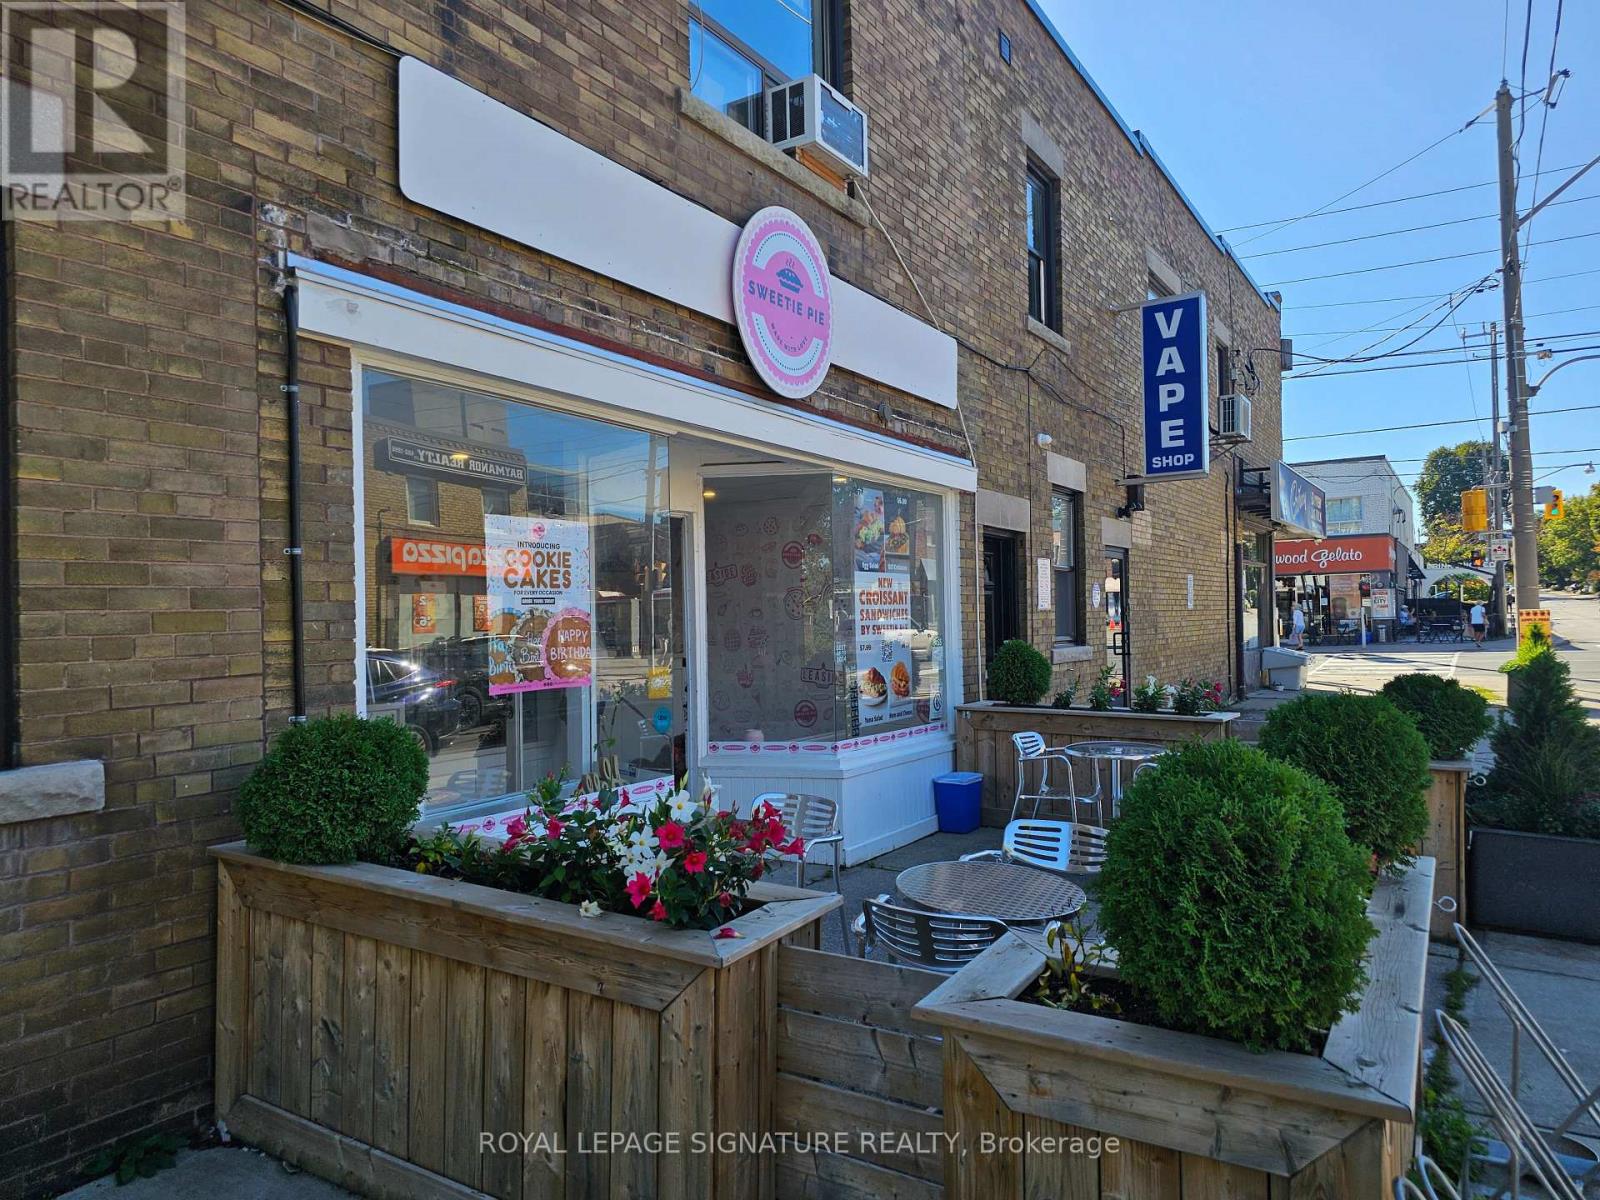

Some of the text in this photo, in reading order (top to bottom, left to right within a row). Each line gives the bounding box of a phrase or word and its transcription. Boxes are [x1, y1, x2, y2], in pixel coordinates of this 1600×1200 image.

[748, 280, 825, 326] SWEETIE PIE
[1154, 308, 1186, 449] VAPE
[1152, 453, 1195, 468] SHOP
[517, 541, 560, 550] INTRODUCING
[504, 549, 572, 568] COOKIE
[1311, 547, 1363, 569] Gelato
[503, 567, 572, 589] CAKES
[878, 577, 893, 588] NEW
[859, 590, 908, 605] CROISSANT
[860, 608, 908, 621] SANDWICHES
[558, 629, 588, 643] HAPPY
[861, 624, 871, 635] BY
